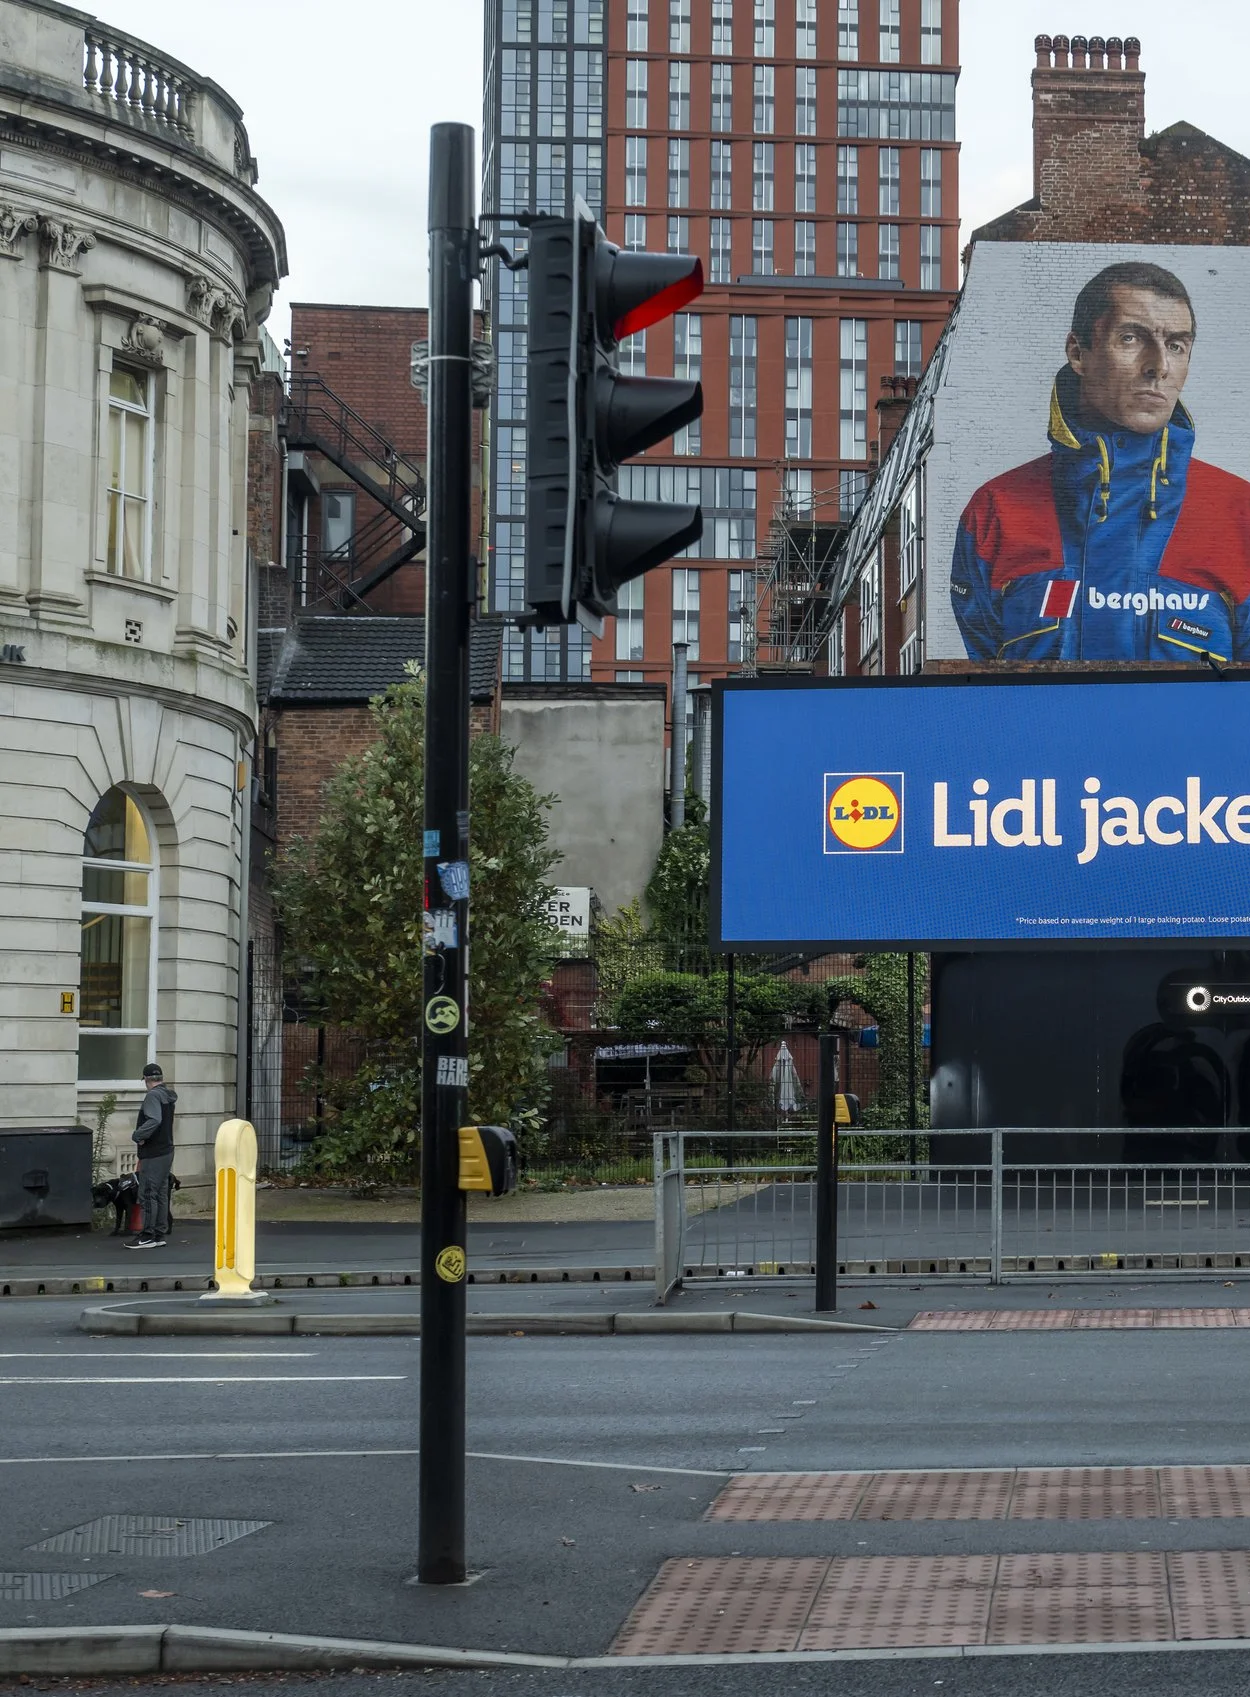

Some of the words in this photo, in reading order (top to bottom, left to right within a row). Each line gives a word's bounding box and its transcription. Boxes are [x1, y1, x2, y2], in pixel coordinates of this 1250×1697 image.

[1088, 586, 1209, 615] berghaus
[1182, 622, 1209, 637] berghaus
[933, 778, 1062, 847] Lidl
[1038, 917, 1060, 925] based
[1071, 918, 1099, 926] average
[1100, 917, 1123, 925] weight
[1124, 916, 1132, 924] of
[1138, 917, 1156, 925] large
[1157, 916, 1181, 925] baking
[1208, 915, 1229, 923] Loose
